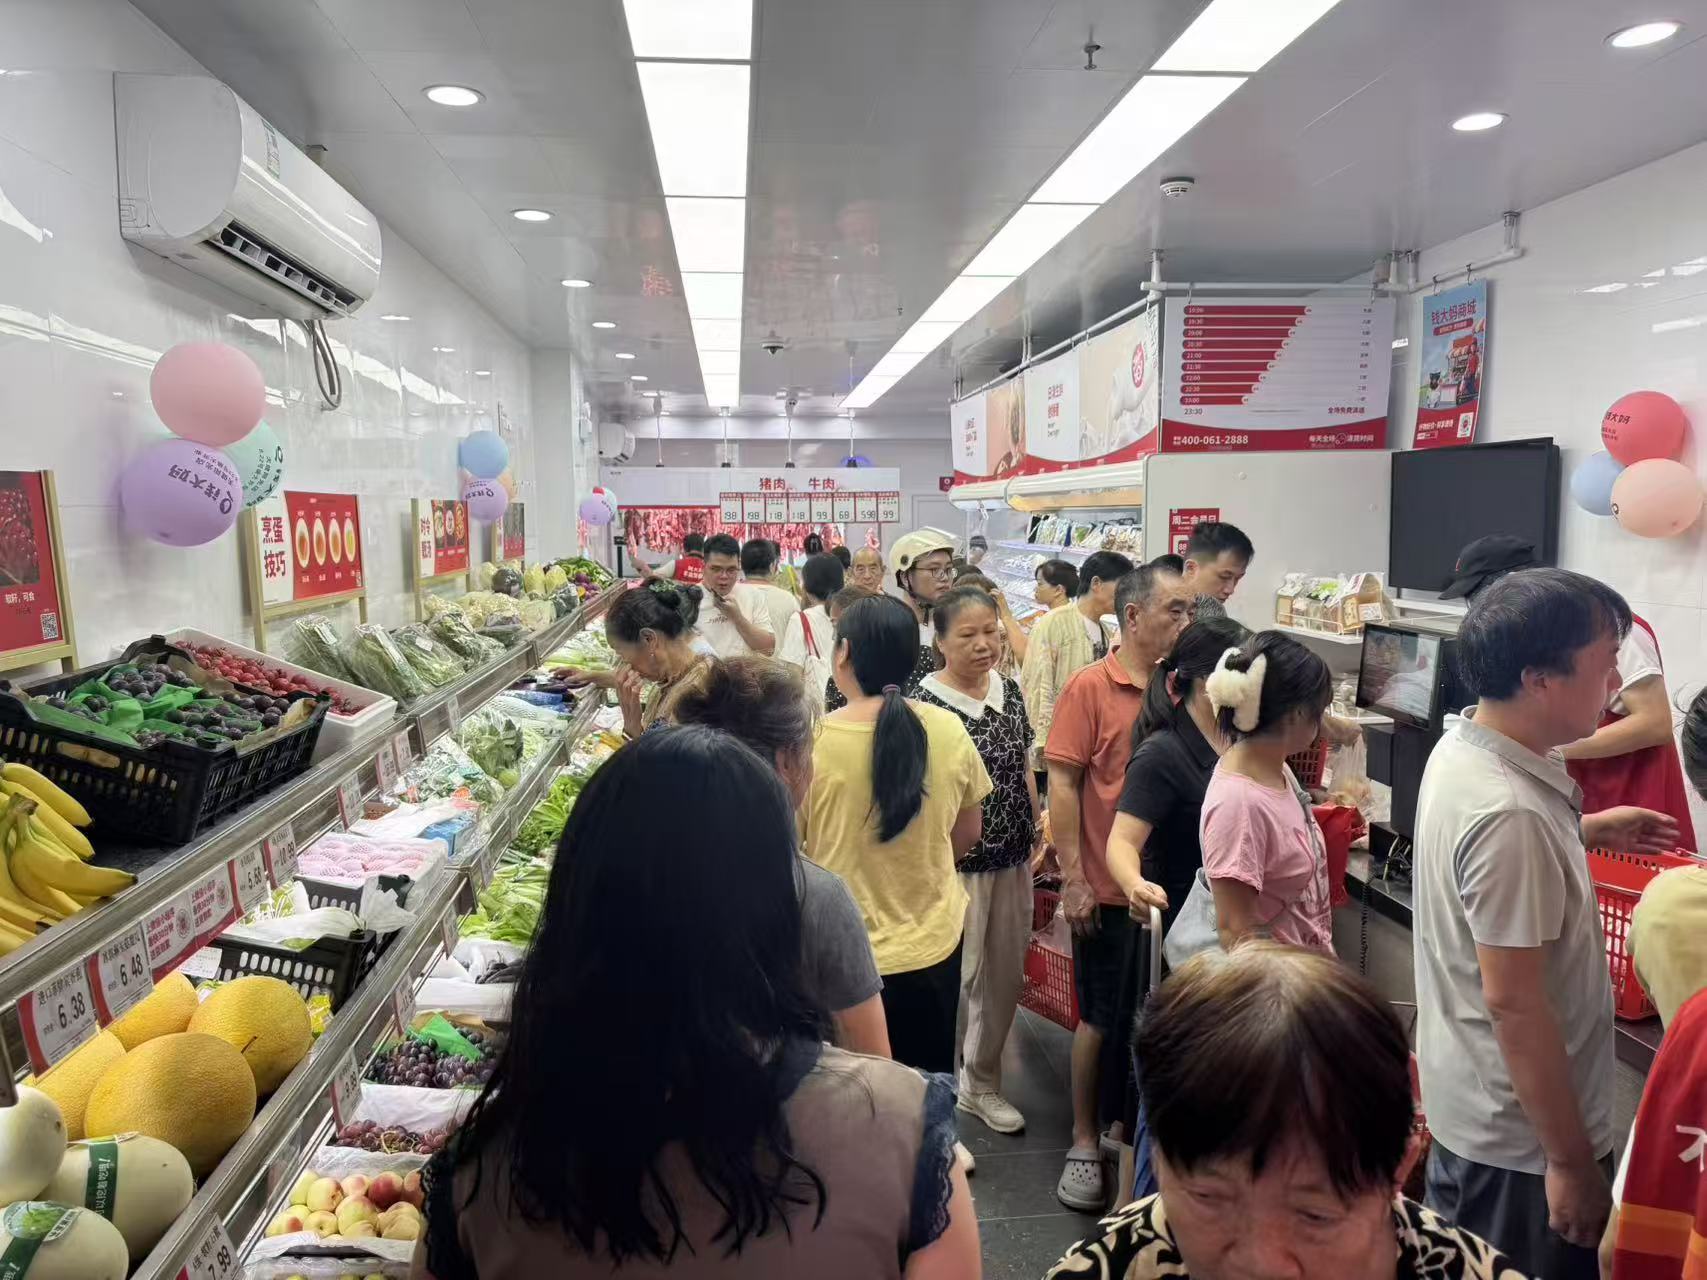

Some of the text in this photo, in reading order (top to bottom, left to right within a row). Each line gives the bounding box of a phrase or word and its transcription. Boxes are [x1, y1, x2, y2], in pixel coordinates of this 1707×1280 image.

[1181, 435, 1249, 445] 400-061-2888
[168, 465, 221, 502] 钱大妈
[759, 478, 835, 491] 猪肉 牛肉
[261, 516, 284, 543] 烹蛋
[264, 550, 286, 578] 技巧
[120, 953, 144, 987] 6.48
[57, 991, 87, 1029] 6.38
